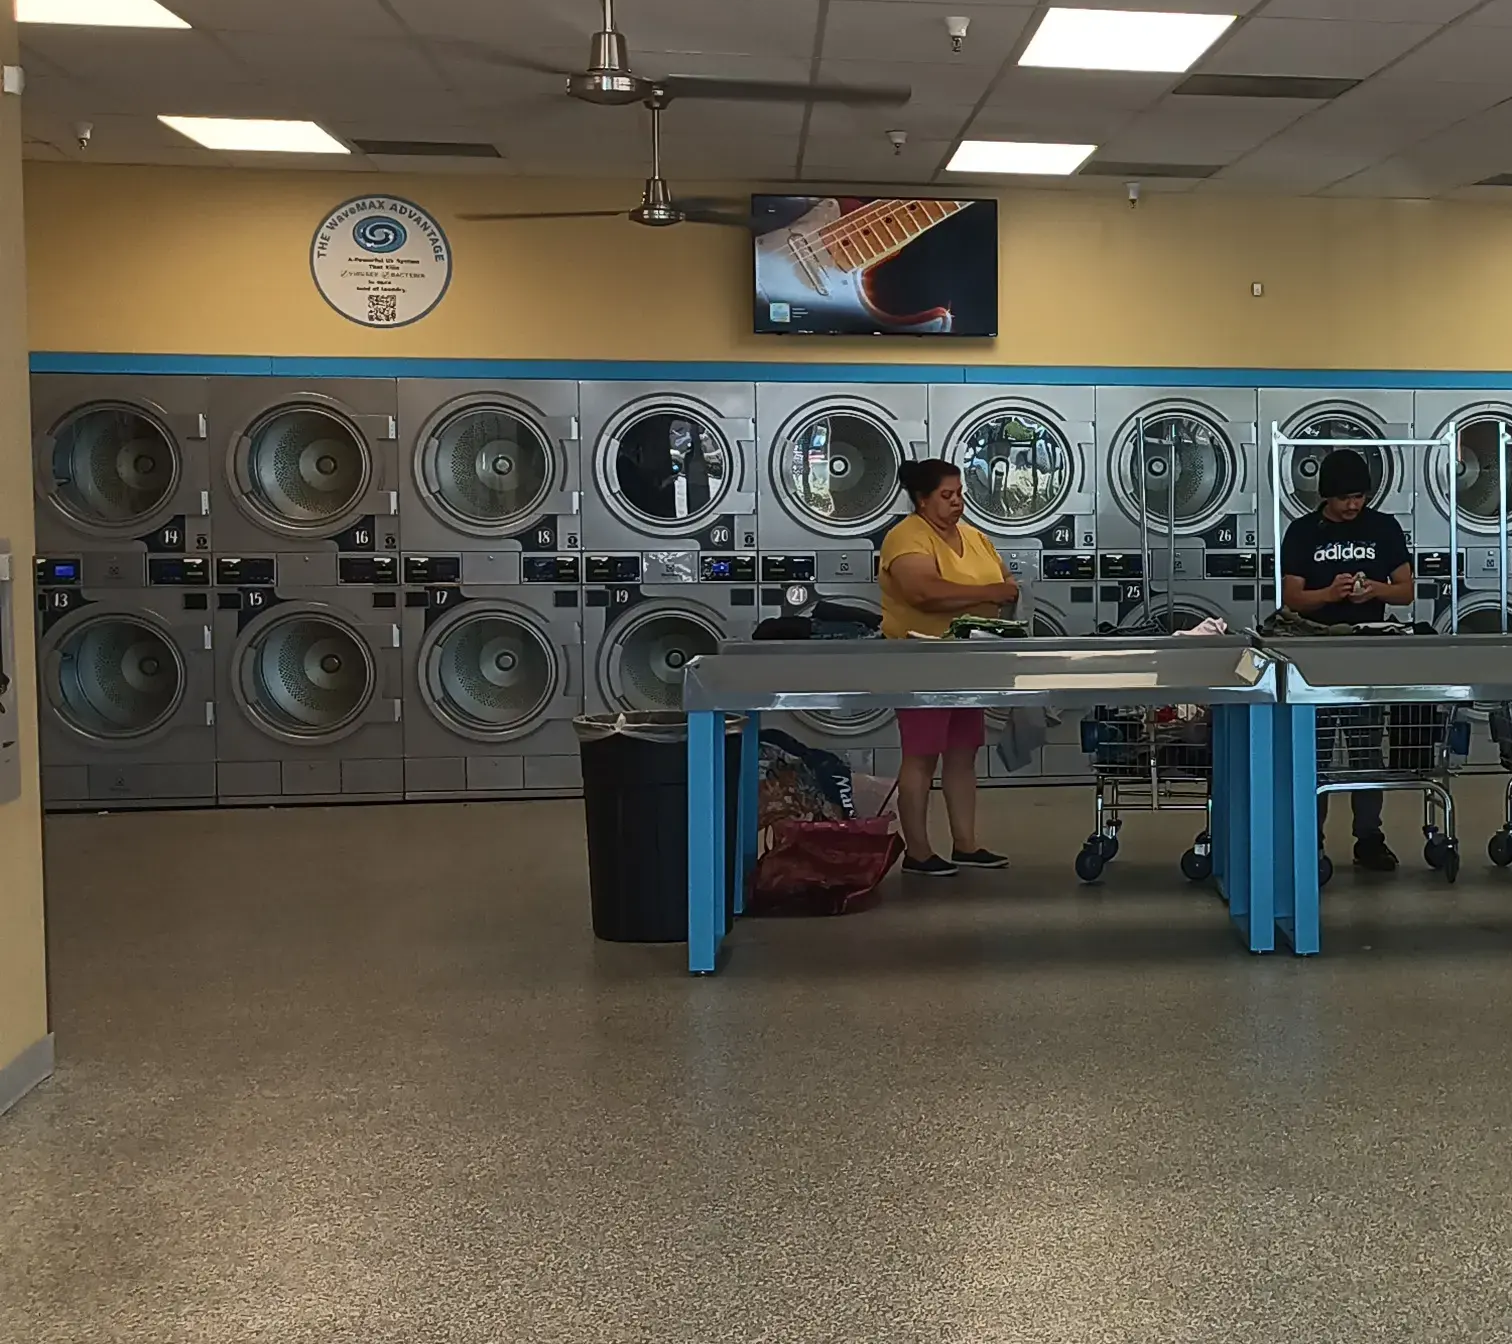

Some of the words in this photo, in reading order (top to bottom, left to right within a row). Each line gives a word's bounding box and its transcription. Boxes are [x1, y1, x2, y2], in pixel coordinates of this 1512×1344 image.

[318, 233, 330, 258] THE
[326, 200, 385, 230] WaveMAX
[389, 204, 444, 262] ADVANTAGE
[164, 529, 178, 544] 14
[355, 530, 369, 544] 16
[537, 530, 550, 544] 18
[713, 529, 728, 542] 20
[1055, 529, 1069, 542] 24
[1218, 529, 1232, 542] 26
[1314, 542, 1376, 562] adidas
[250, 592, 262, 606] 15
[436, 590, 448, 605] 17
[616, 590, 629, 603] 19
[791, 588, 803, 602] 21
[1127, 586, 1140, 598] 25
[54, 593, 68, 607] 13
